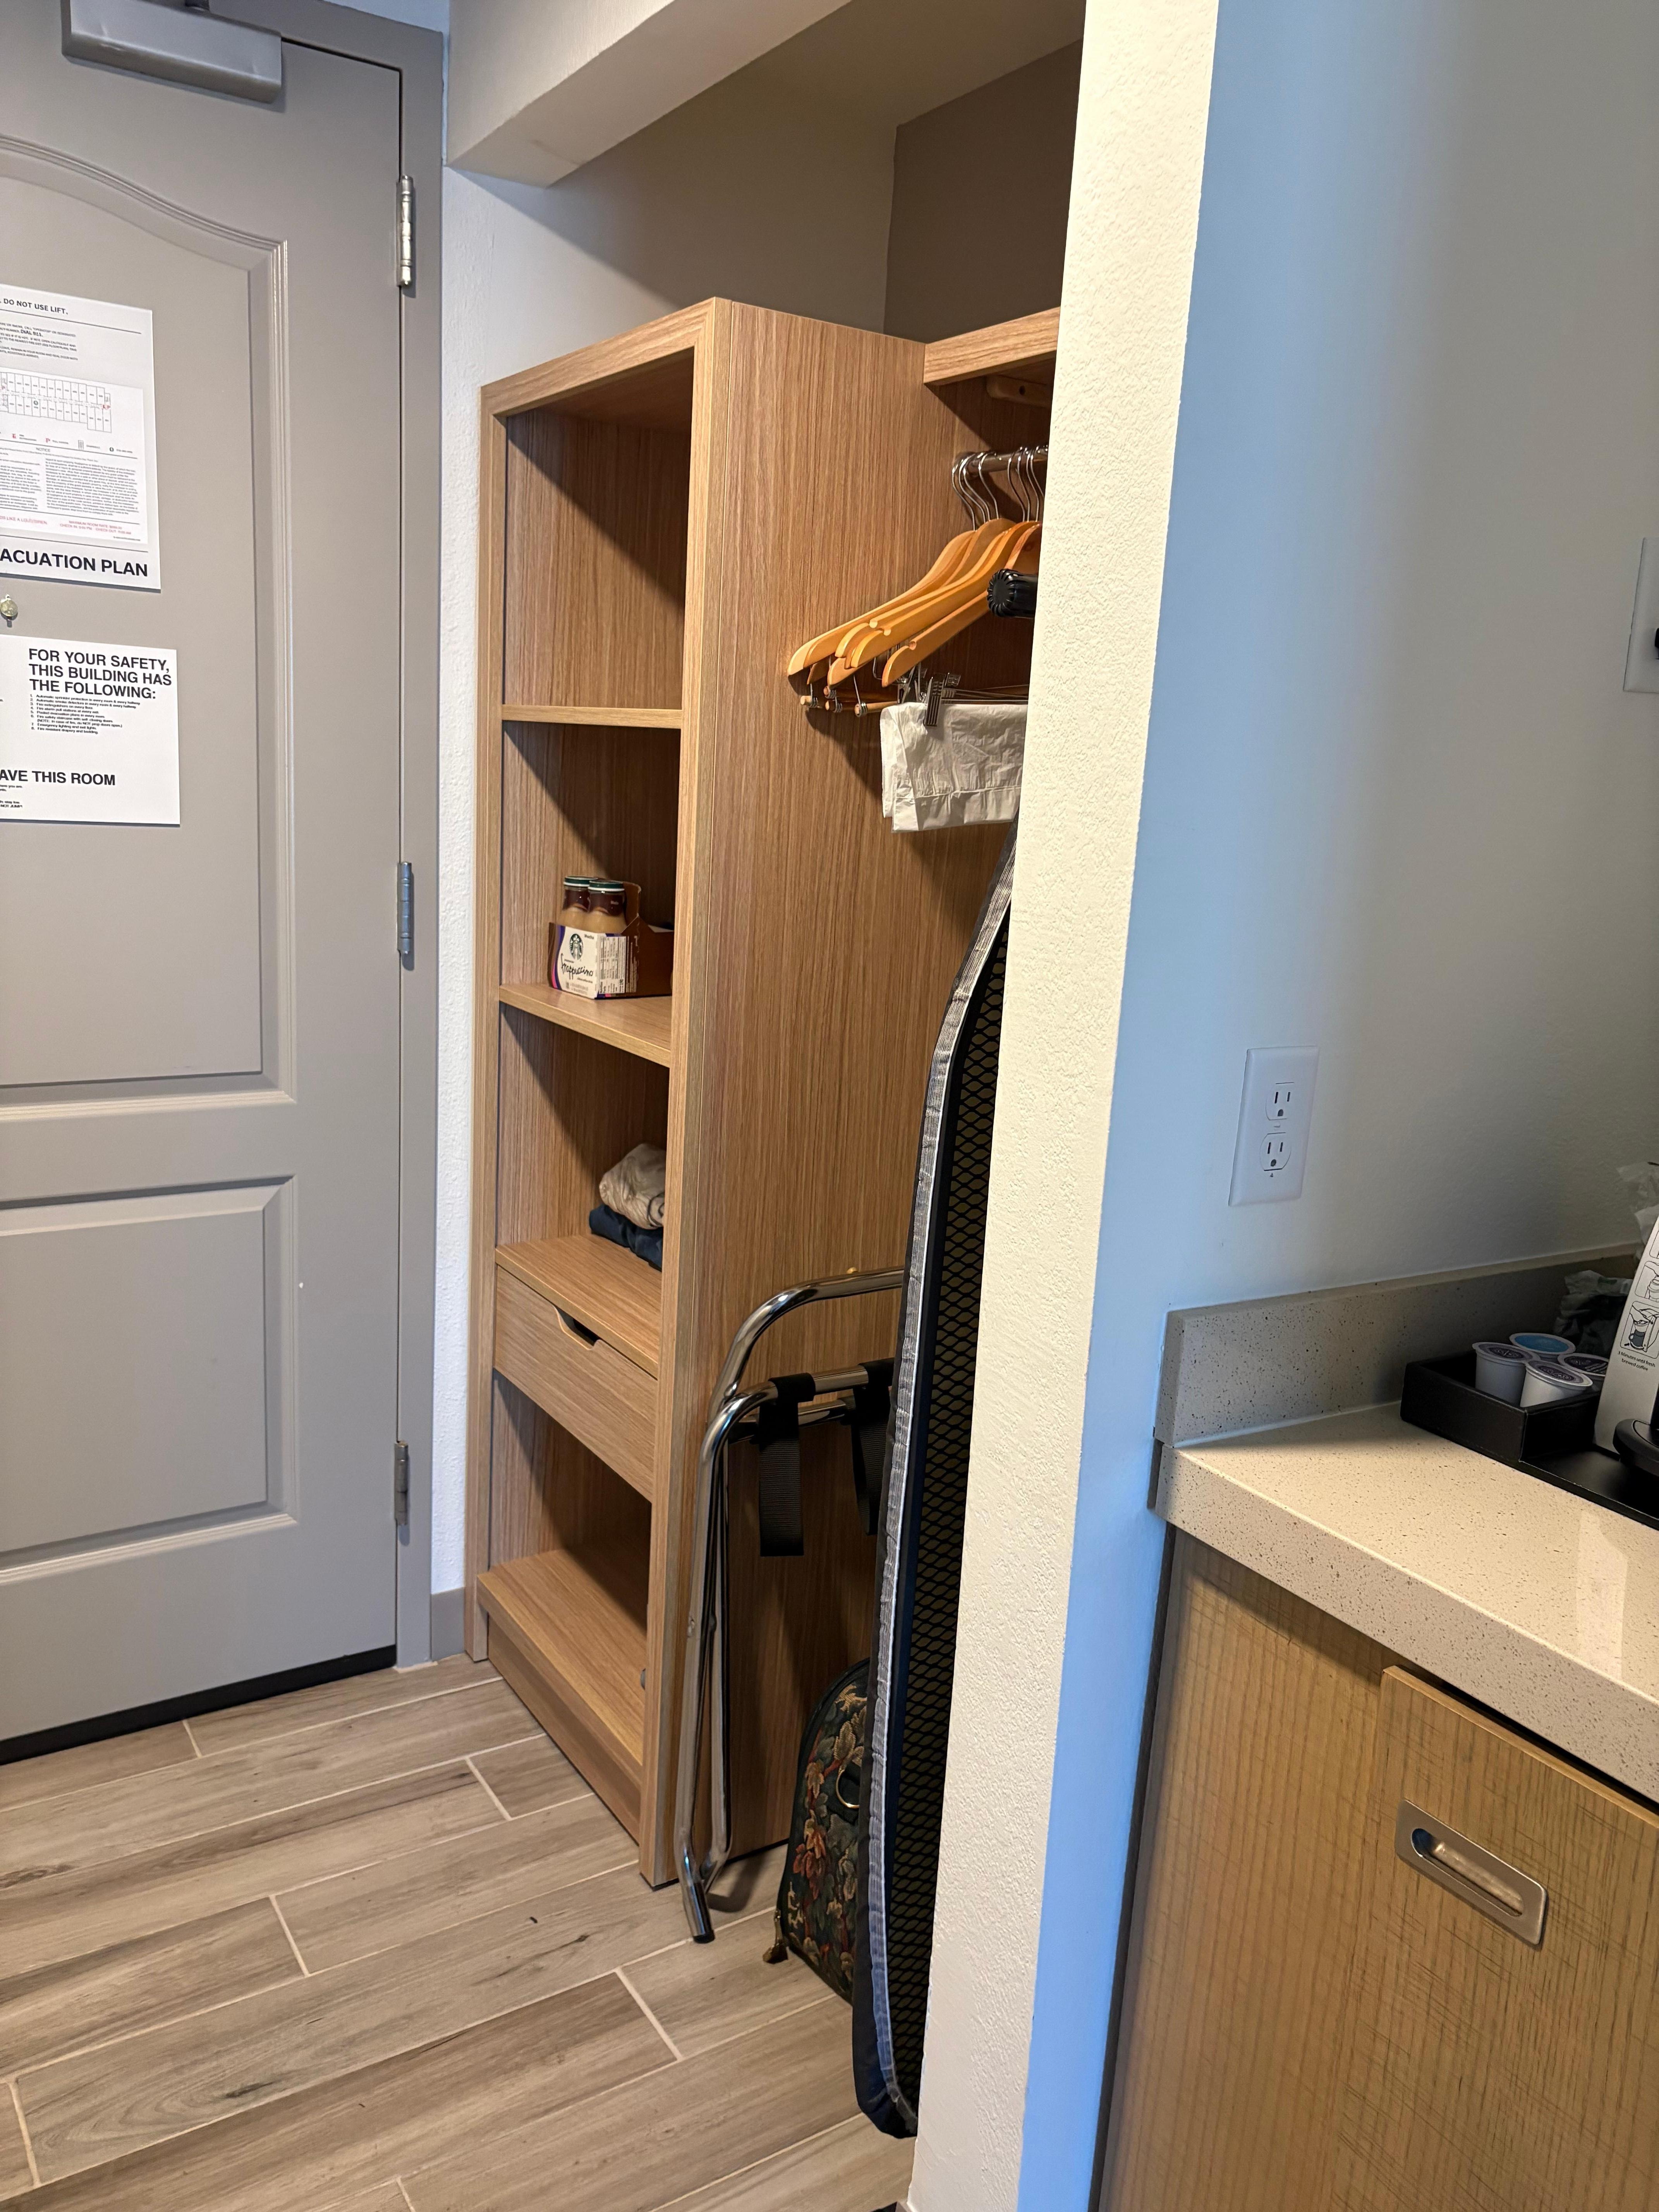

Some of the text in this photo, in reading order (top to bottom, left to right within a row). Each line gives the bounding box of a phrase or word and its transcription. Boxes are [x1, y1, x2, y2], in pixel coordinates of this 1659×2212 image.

[50, 306, 68, 314] LIFT.
[0, 548, 148, 577] ACUATION PLAN
[29, 648, 169, 673] FOR YOUR SAFETY,
[29, 664, 172, 685] THIS BUILDING HAS
[29, 679, 156, 699] THE FOLLOWING:
[0, 769, 115, 785] AVE THIS ROOM
[1621, 1352, 1636, 1360] Minutes
